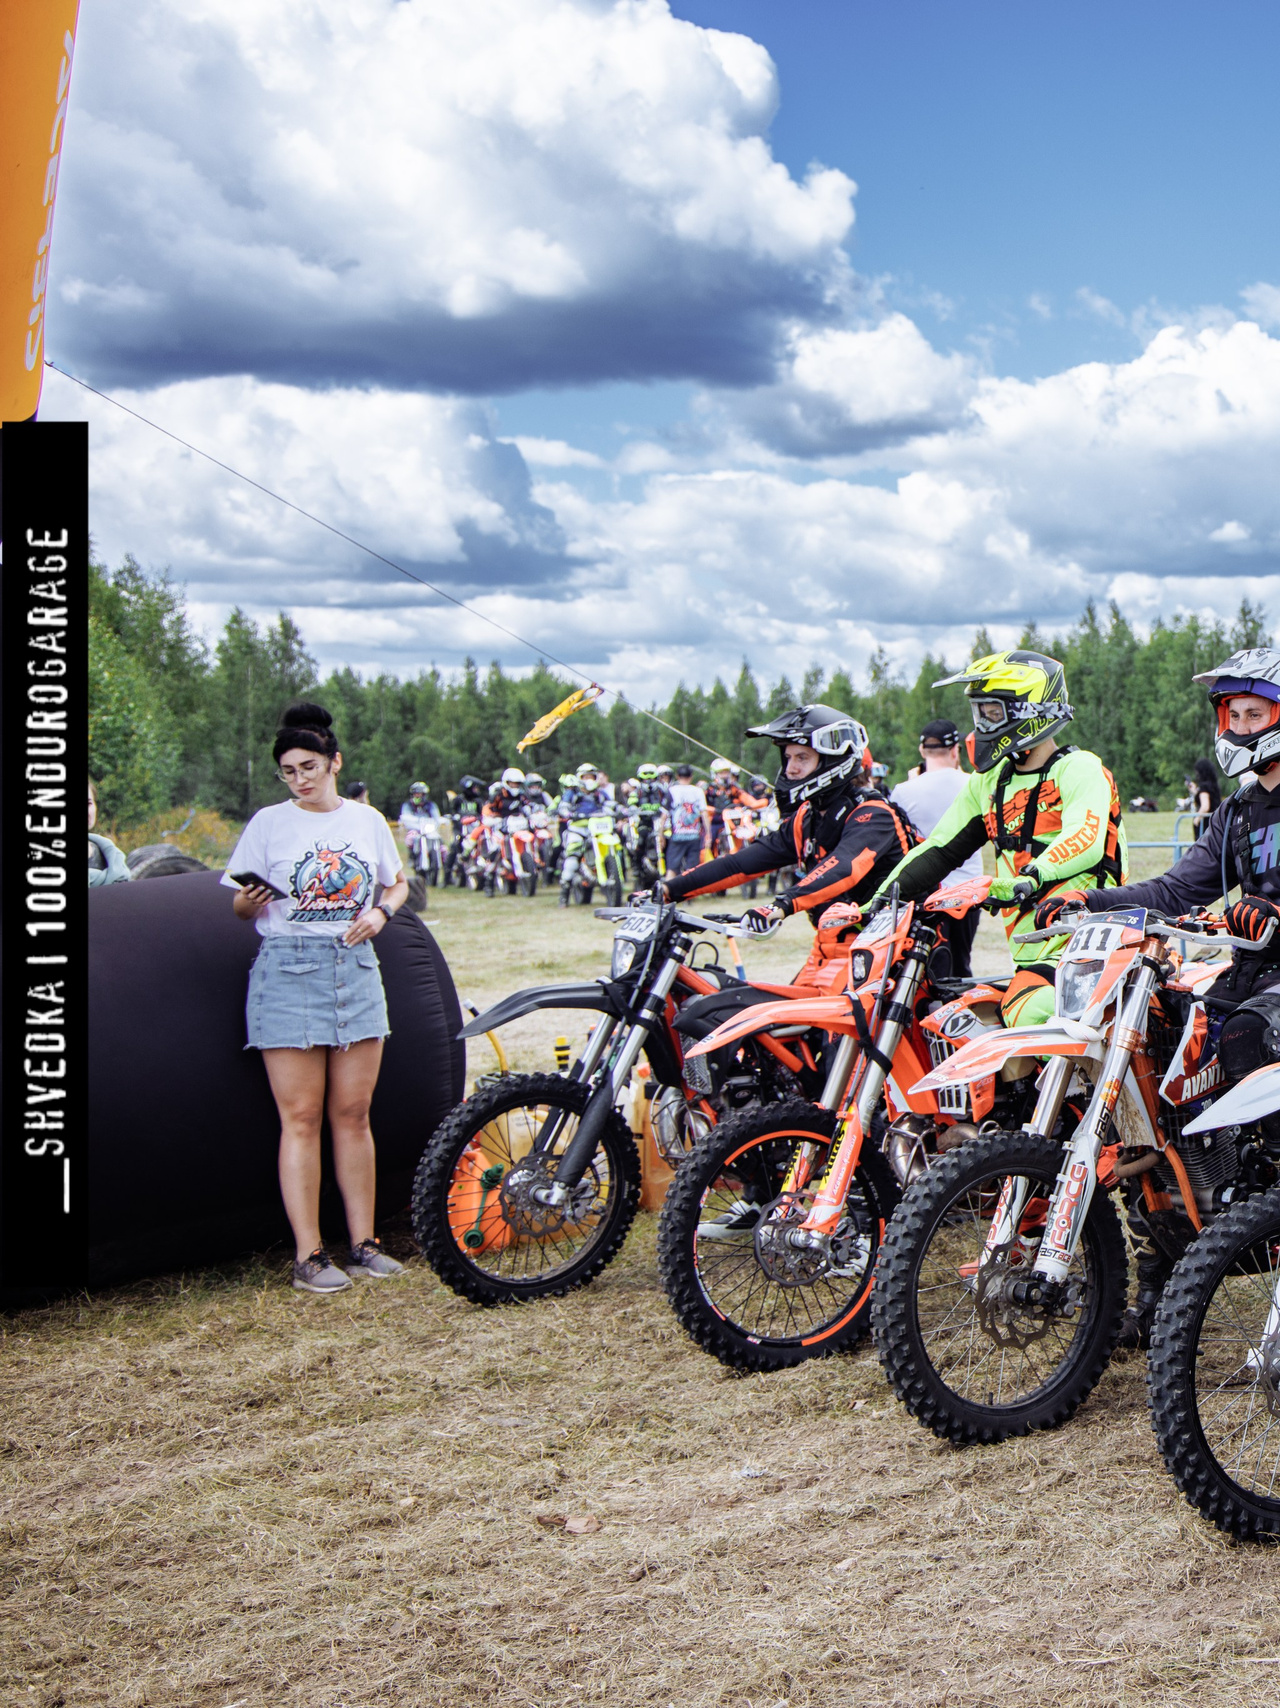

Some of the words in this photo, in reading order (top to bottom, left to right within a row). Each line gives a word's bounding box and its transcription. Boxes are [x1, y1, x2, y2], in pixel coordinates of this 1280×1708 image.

[1047, 809, 1100, 864] JUSTCAT
[619, 916, 656, 933] 603
[1068, 926, 1113, 954] 611
[1050, 1163, 1089, 1250] FORCE
